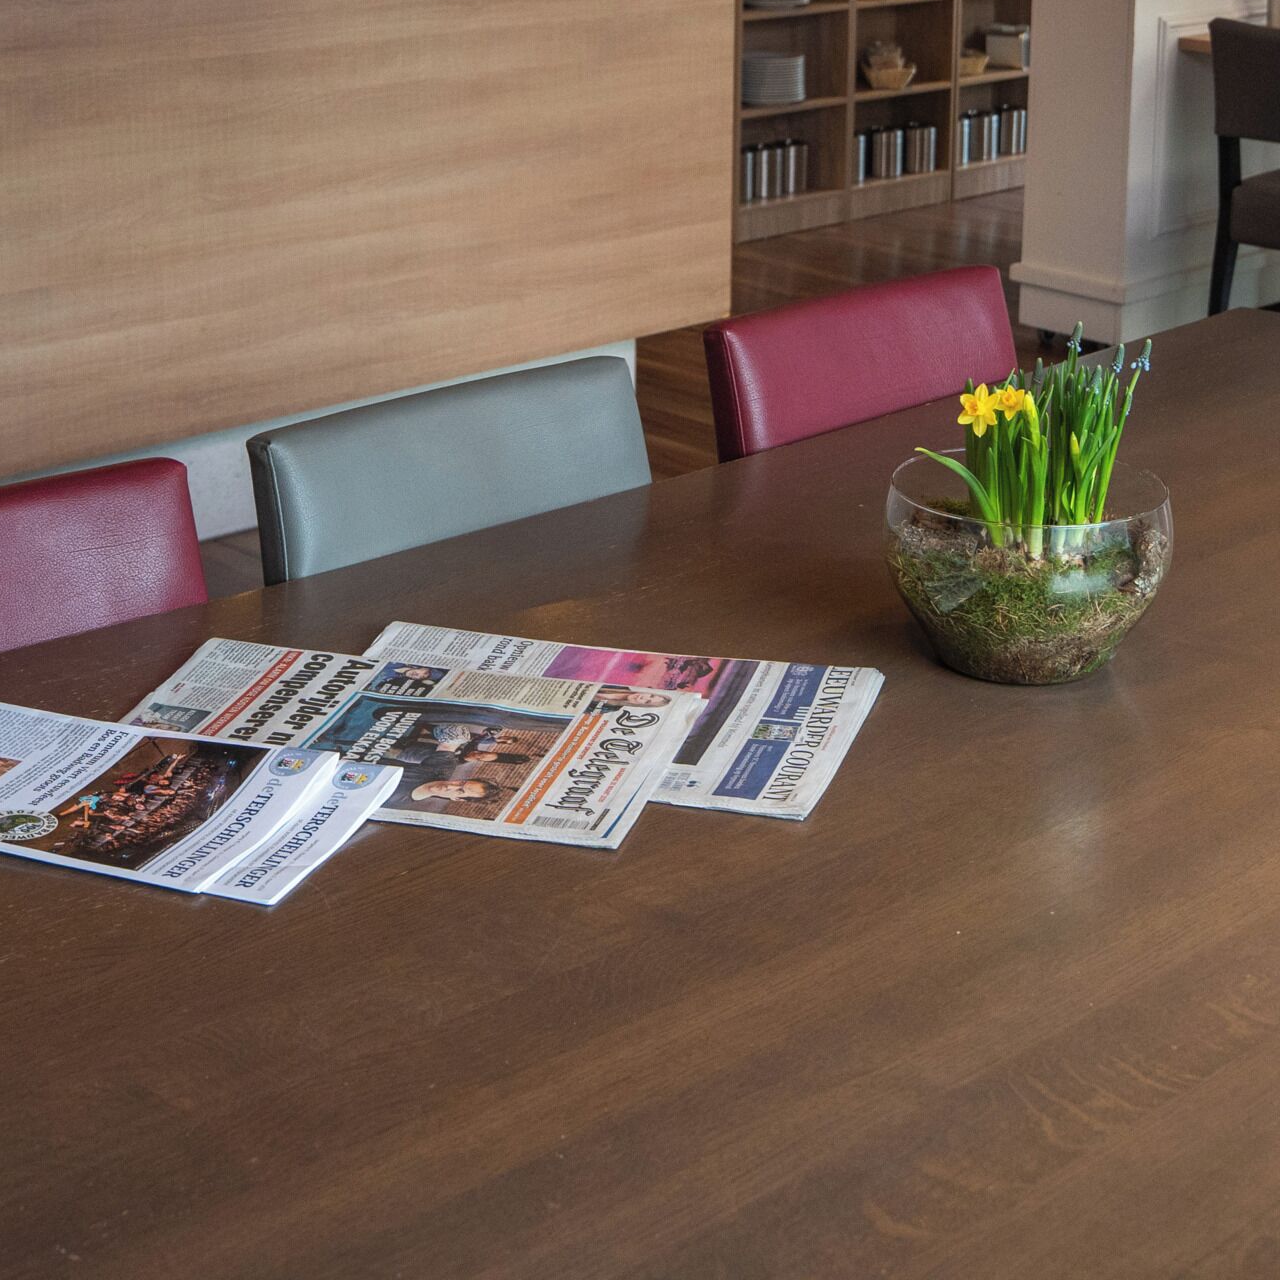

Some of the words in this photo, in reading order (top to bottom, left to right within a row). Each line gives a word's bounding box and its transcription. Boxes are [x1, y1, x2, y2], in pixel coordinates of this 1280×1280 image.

[490, 637, 513, 654] rond
[499, 641, 533, 671] Opnieuw
[475, 654, 501, 671] bakk
[368, 709, 402, 733] VOOR
[795, 666, 854, 749] EEUWARDER
[96, 728, 118, 742] Bos
[384, 711, 422, 738] BUURT
[610, 710, 660, 737] De
[83, 730, 129, 766] Formerum
[86, 742, 104, 752] en
[340, 731, 379, 760] ELKAA
[53, 752, 93, 774] Badweg
[64, 765, 91, 779] viert
[544, 737, 643, 816] Telegraaf
[762, 750, 813, 802] COURANT
[31, 773, 62, 792] groots
[161, 778, 283, 878] deTERSCHELLINGER
[234, 791, 347, 888] deTERSCHELLINGER
